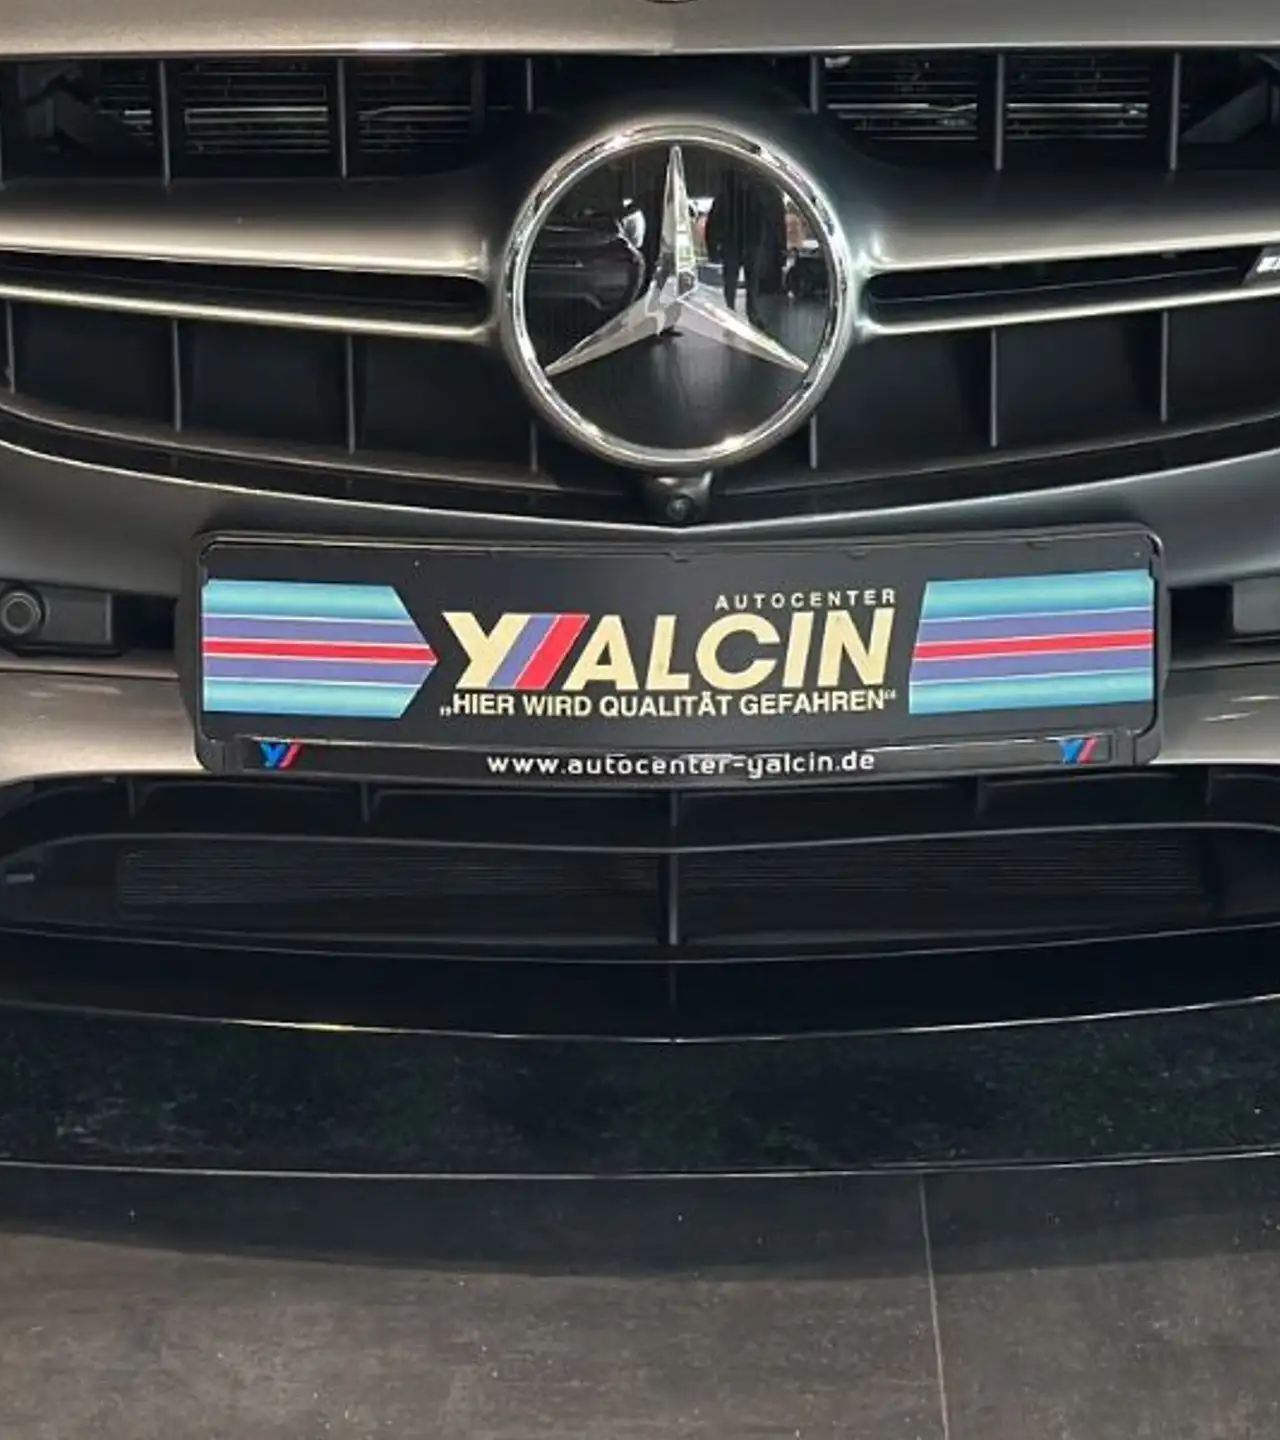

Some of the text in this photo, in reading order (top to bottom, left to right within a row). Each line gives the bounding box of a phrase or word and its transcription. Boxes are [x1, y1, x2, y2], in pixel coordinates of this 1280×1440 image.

[714, 588, 897, 611] AUTOCENTER
[522, 695, 592, 718] WIRD
[599, 690, 733, 718] QUALITÄT
[486, 749, 876, 780] www.autocenter-yalcin.de
